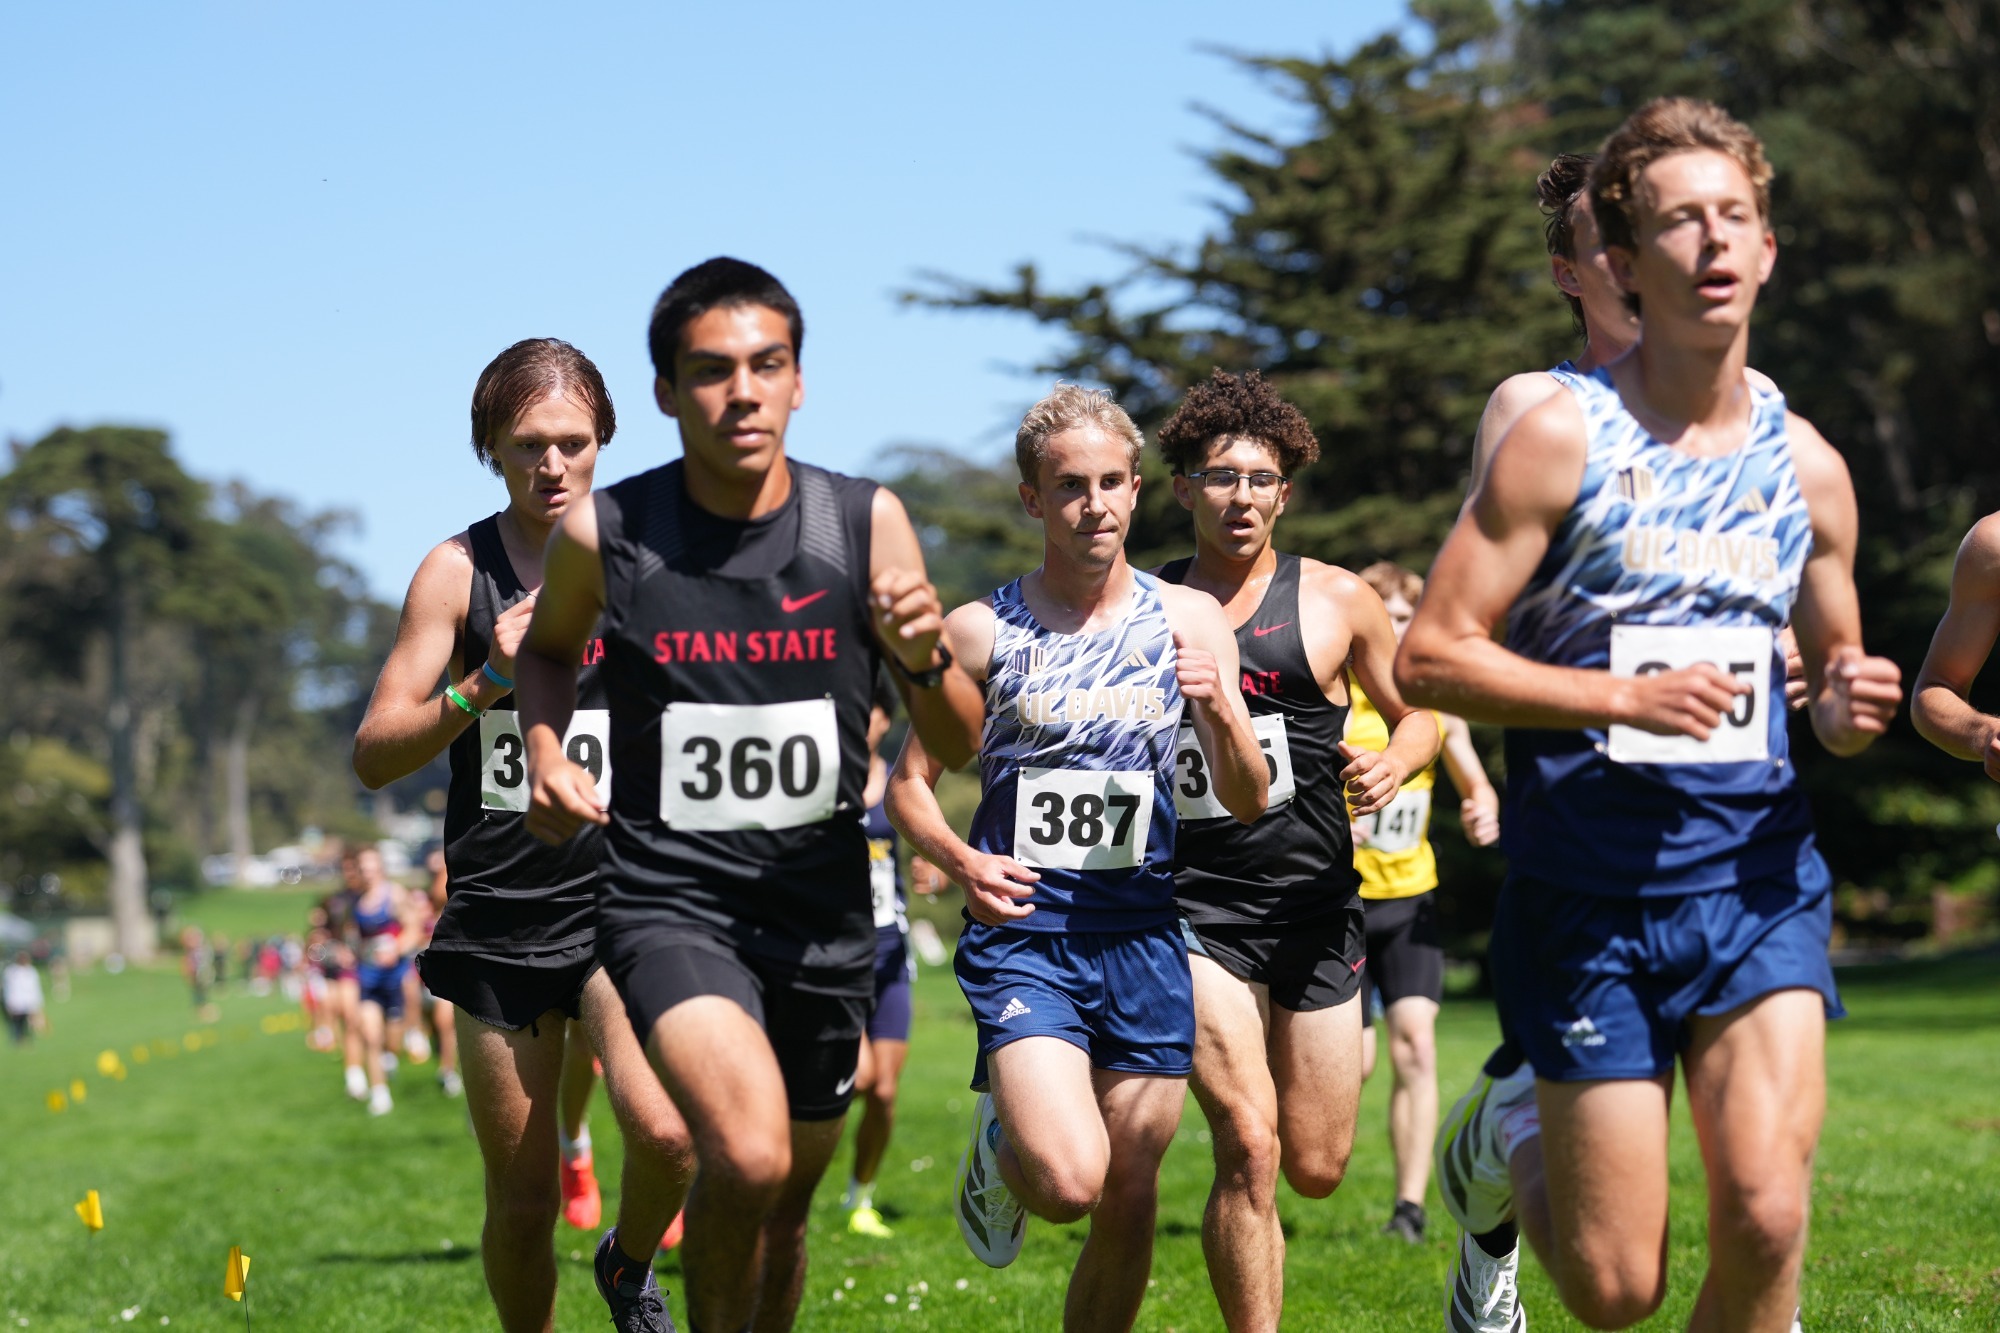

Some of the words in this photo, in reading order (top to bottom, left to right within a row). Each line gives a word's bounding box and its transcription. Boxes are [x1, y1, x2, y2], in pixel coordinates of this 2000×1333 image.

[1623, 527, 1673, 571] UC
[1679, 533, 1776, 581] DAVIS
[654, 630, 738, 664] STAN
[746, 628, 837, 663] STATE
[1017, 690, 1060, 726] UC
[1066, 687, 1165, 721] DAVIS
[1241, 671, 1283, 695] ATE
[493, 733, 603, 788] 39
[681, 734, 820, 800] 360
[1177, 738, 1278, 798] 35
[1029, 791, 1141, 847] 387
[998, 1007, 1031, 1023] adidas
